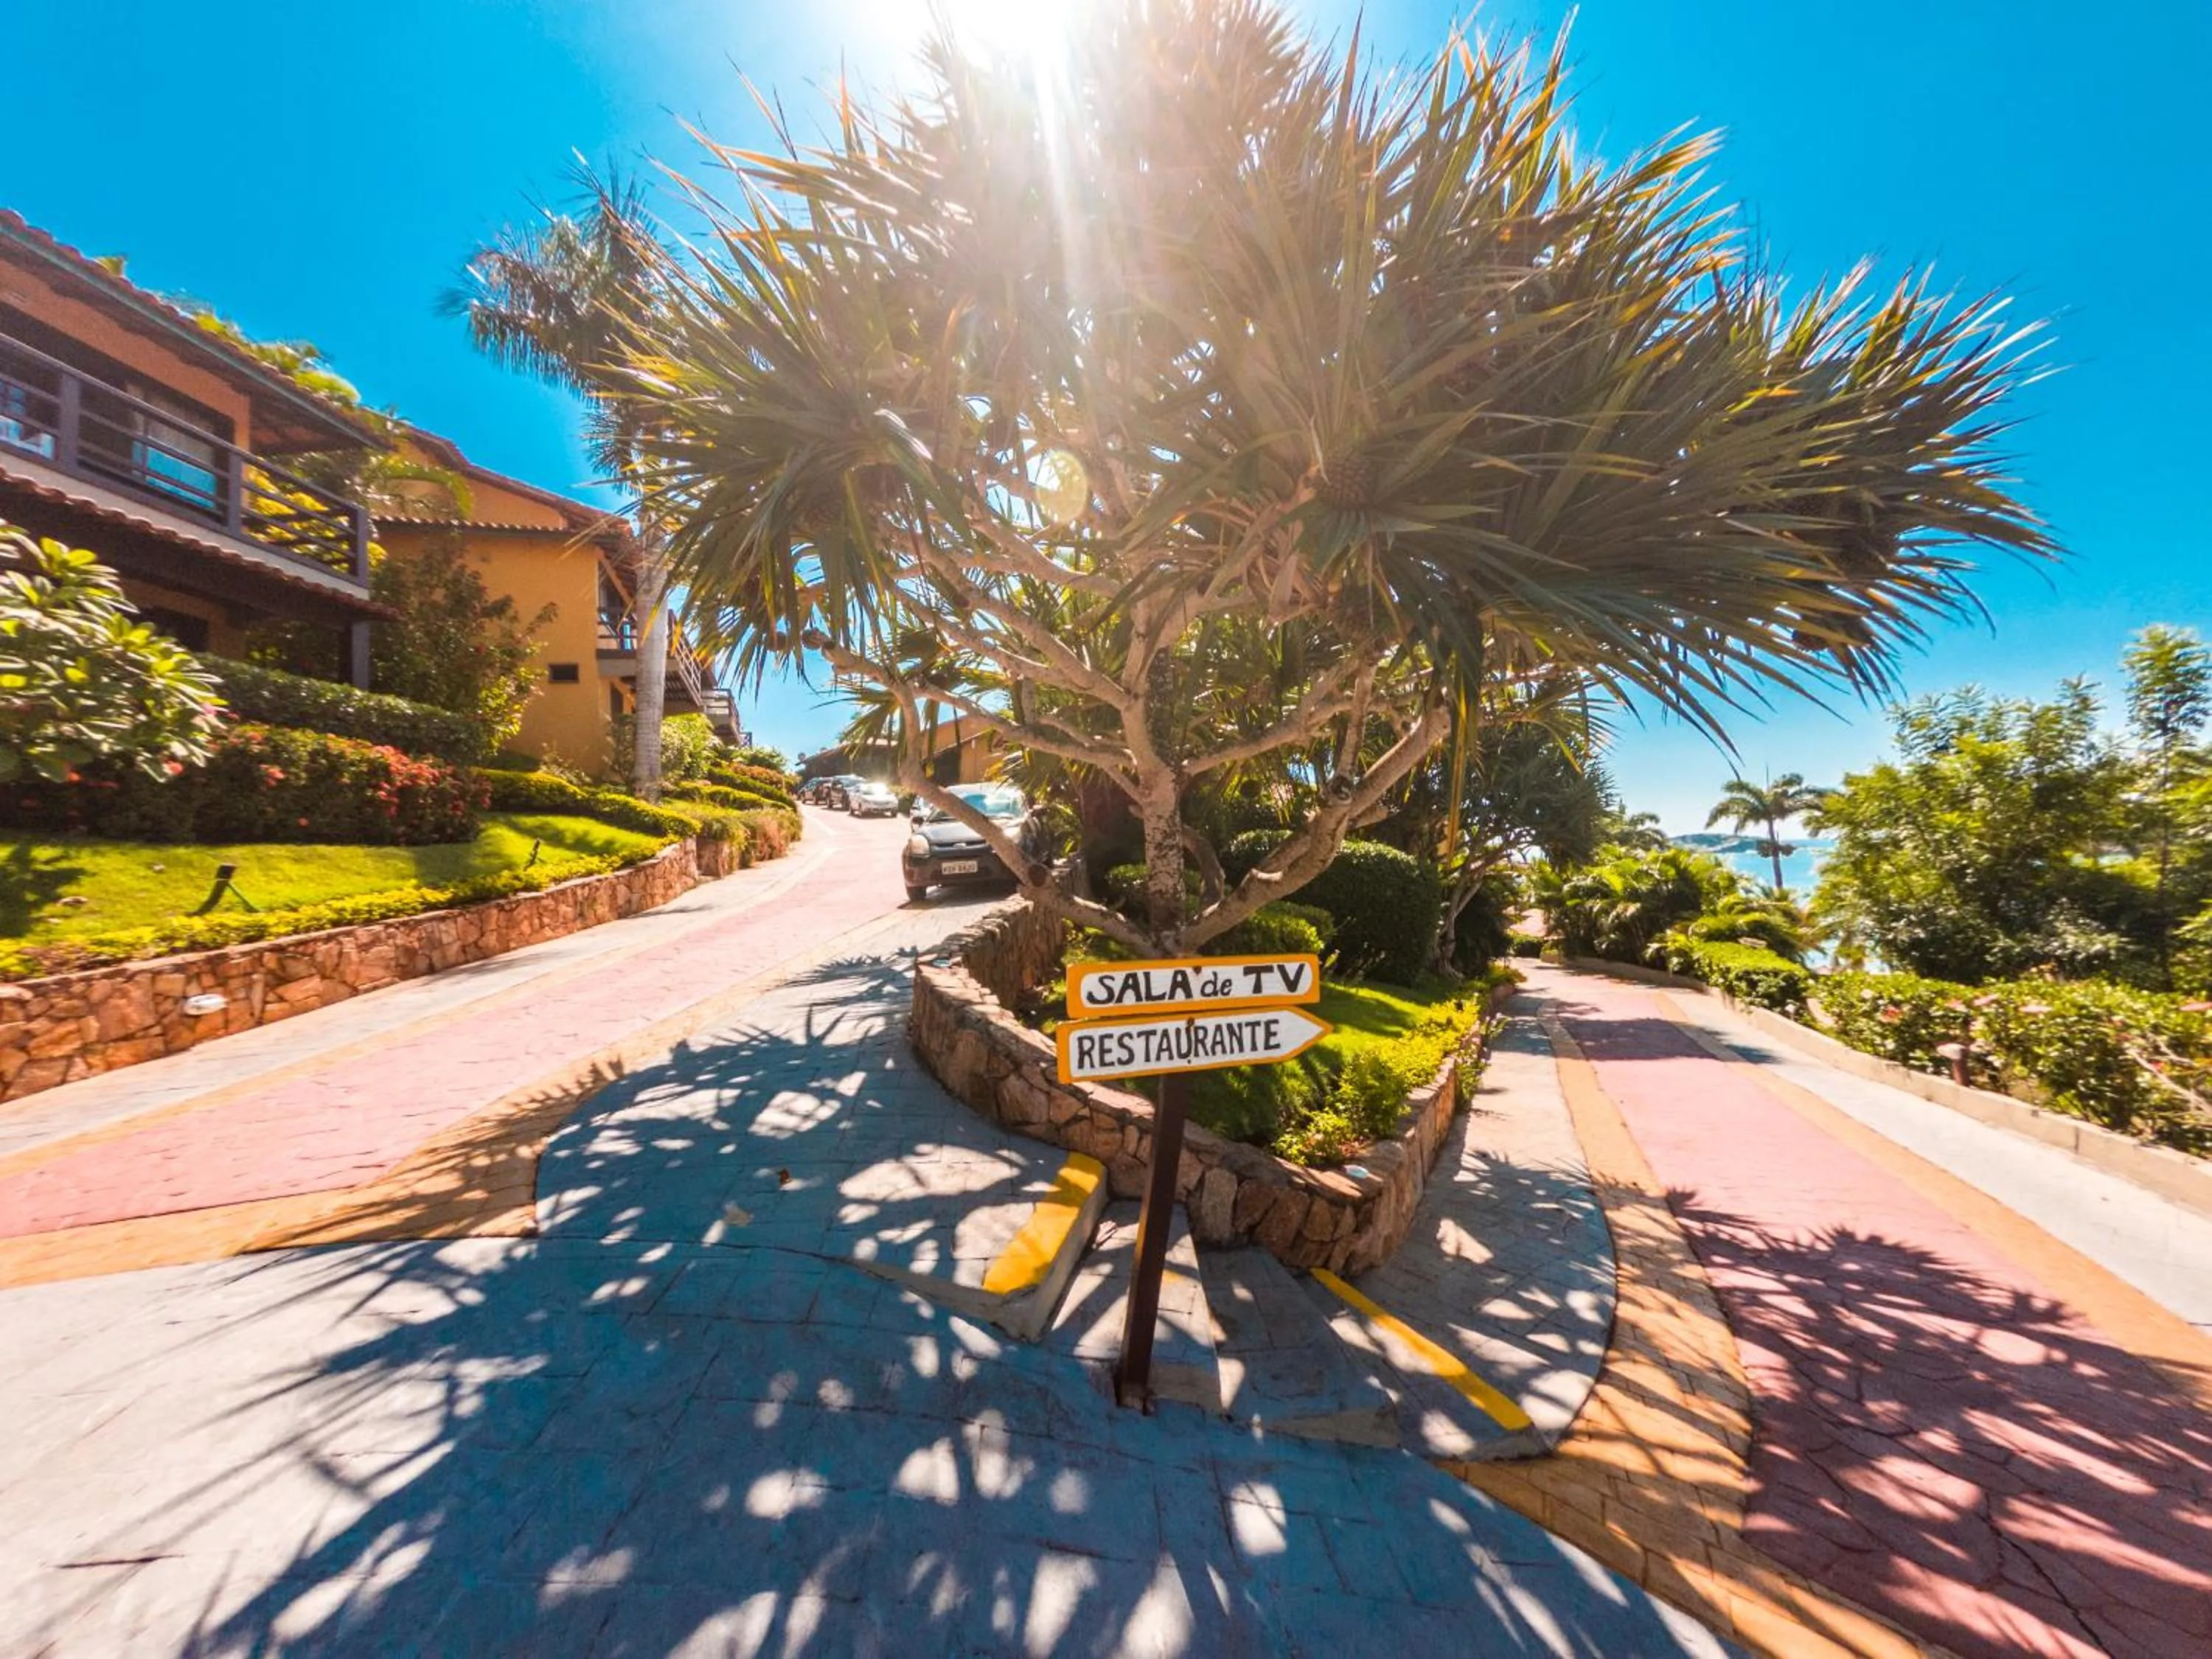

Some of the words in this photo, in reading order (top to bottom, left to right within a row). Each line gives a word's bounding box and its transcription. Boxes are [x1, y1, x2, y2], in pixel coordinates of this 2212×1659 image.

[1086, 970, 1194, 1005] SALA
[1200, 972, 1233, 997] de
[1243, 963, 1306, 995] TV
[1077, 1019, 1281, 1069] RESTAURANTE
